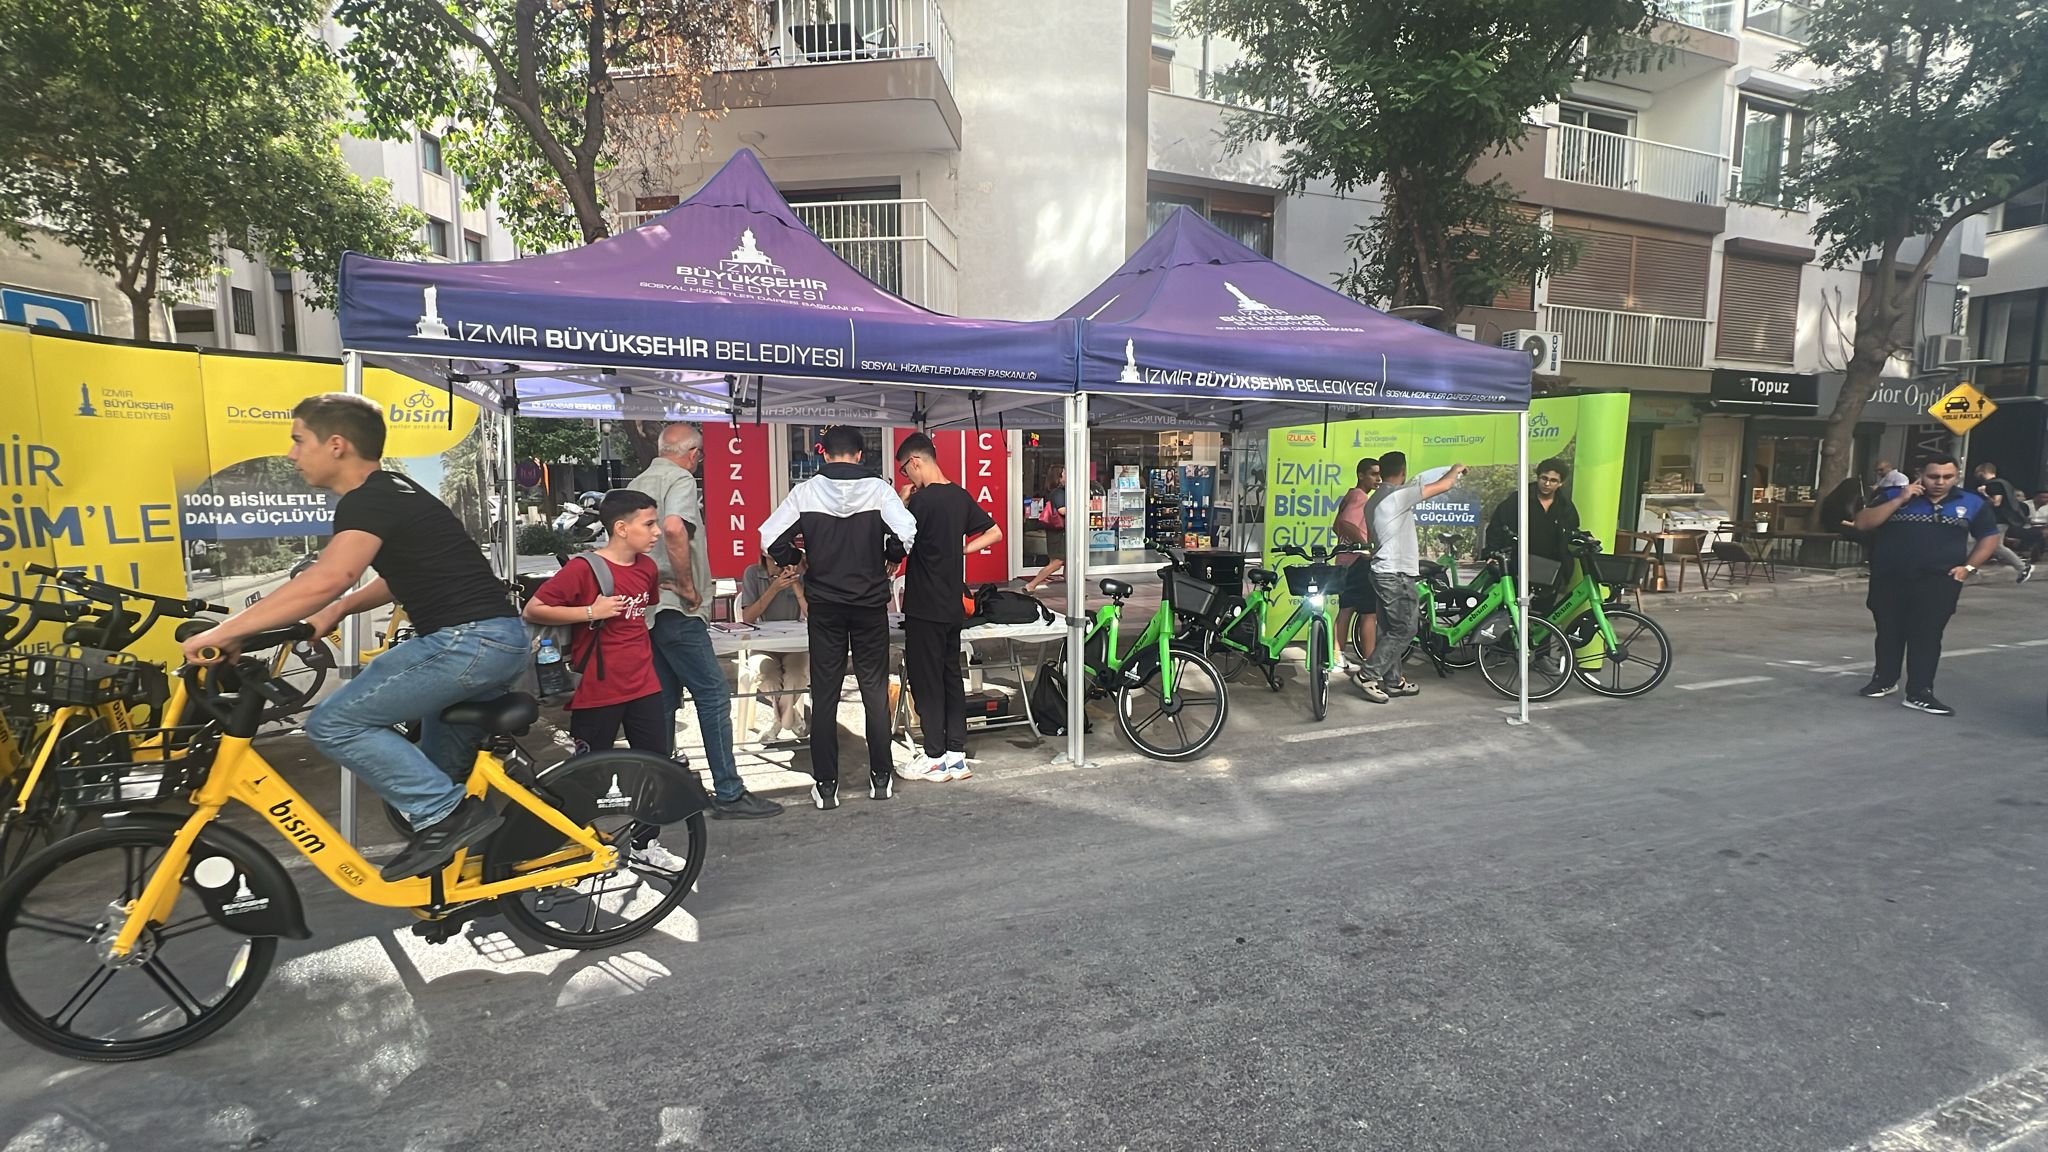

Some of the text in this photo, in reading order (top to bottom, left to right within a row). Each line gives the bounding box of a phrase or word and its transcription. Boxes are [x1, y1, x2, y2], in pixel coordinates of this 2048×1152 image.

[676, 266, 828, 291] BÜYÜKŞEHİR
[684, 276, 824, 301] BELEDİYESİ
[458, 320, 537, 347] İZMİR
[545, 327, 708, 358] BÜYÜKŞEHİR
[716, 340, 844, 368] BELEDİYESİ
[861, 360, 898, 372] SOSYAL
[900, 363, 951, 375] HİZMETLER
[953, 366, 987, 378] DAİRESİ
[1145, 368, 1193, 386] İZMİR
[1195, 371, 1294, 392] BÜYÜKŞEHİR
[1296, 379, 1378, 397] BELEDİYESİ
[1386, 389, 1411, 399] SOSYAL
[1750, 378, 1790, 396] Topuz
[103, 399, 174, 411] BÜYÜKŞEHİR
[105, 409, 172, 420] BELEDİYESİ
[390, 404, 450, 423] bisim
[1276, 458, 1342, 485] İZMİR
[184, 491, 327, 507] 1000 BİSİKLETLE
[1415, 501, 1470, 511] BİSİKLETLE
[185, 512, 237, 525] DAHA
[1420, 512, 1475, 523] GÜÇLÜYÜZ
[1468, 603, 1489, 623] ebisim
[1551, 601, 1573, 621] ebisim
[268, 799, 326, 854] bisim
